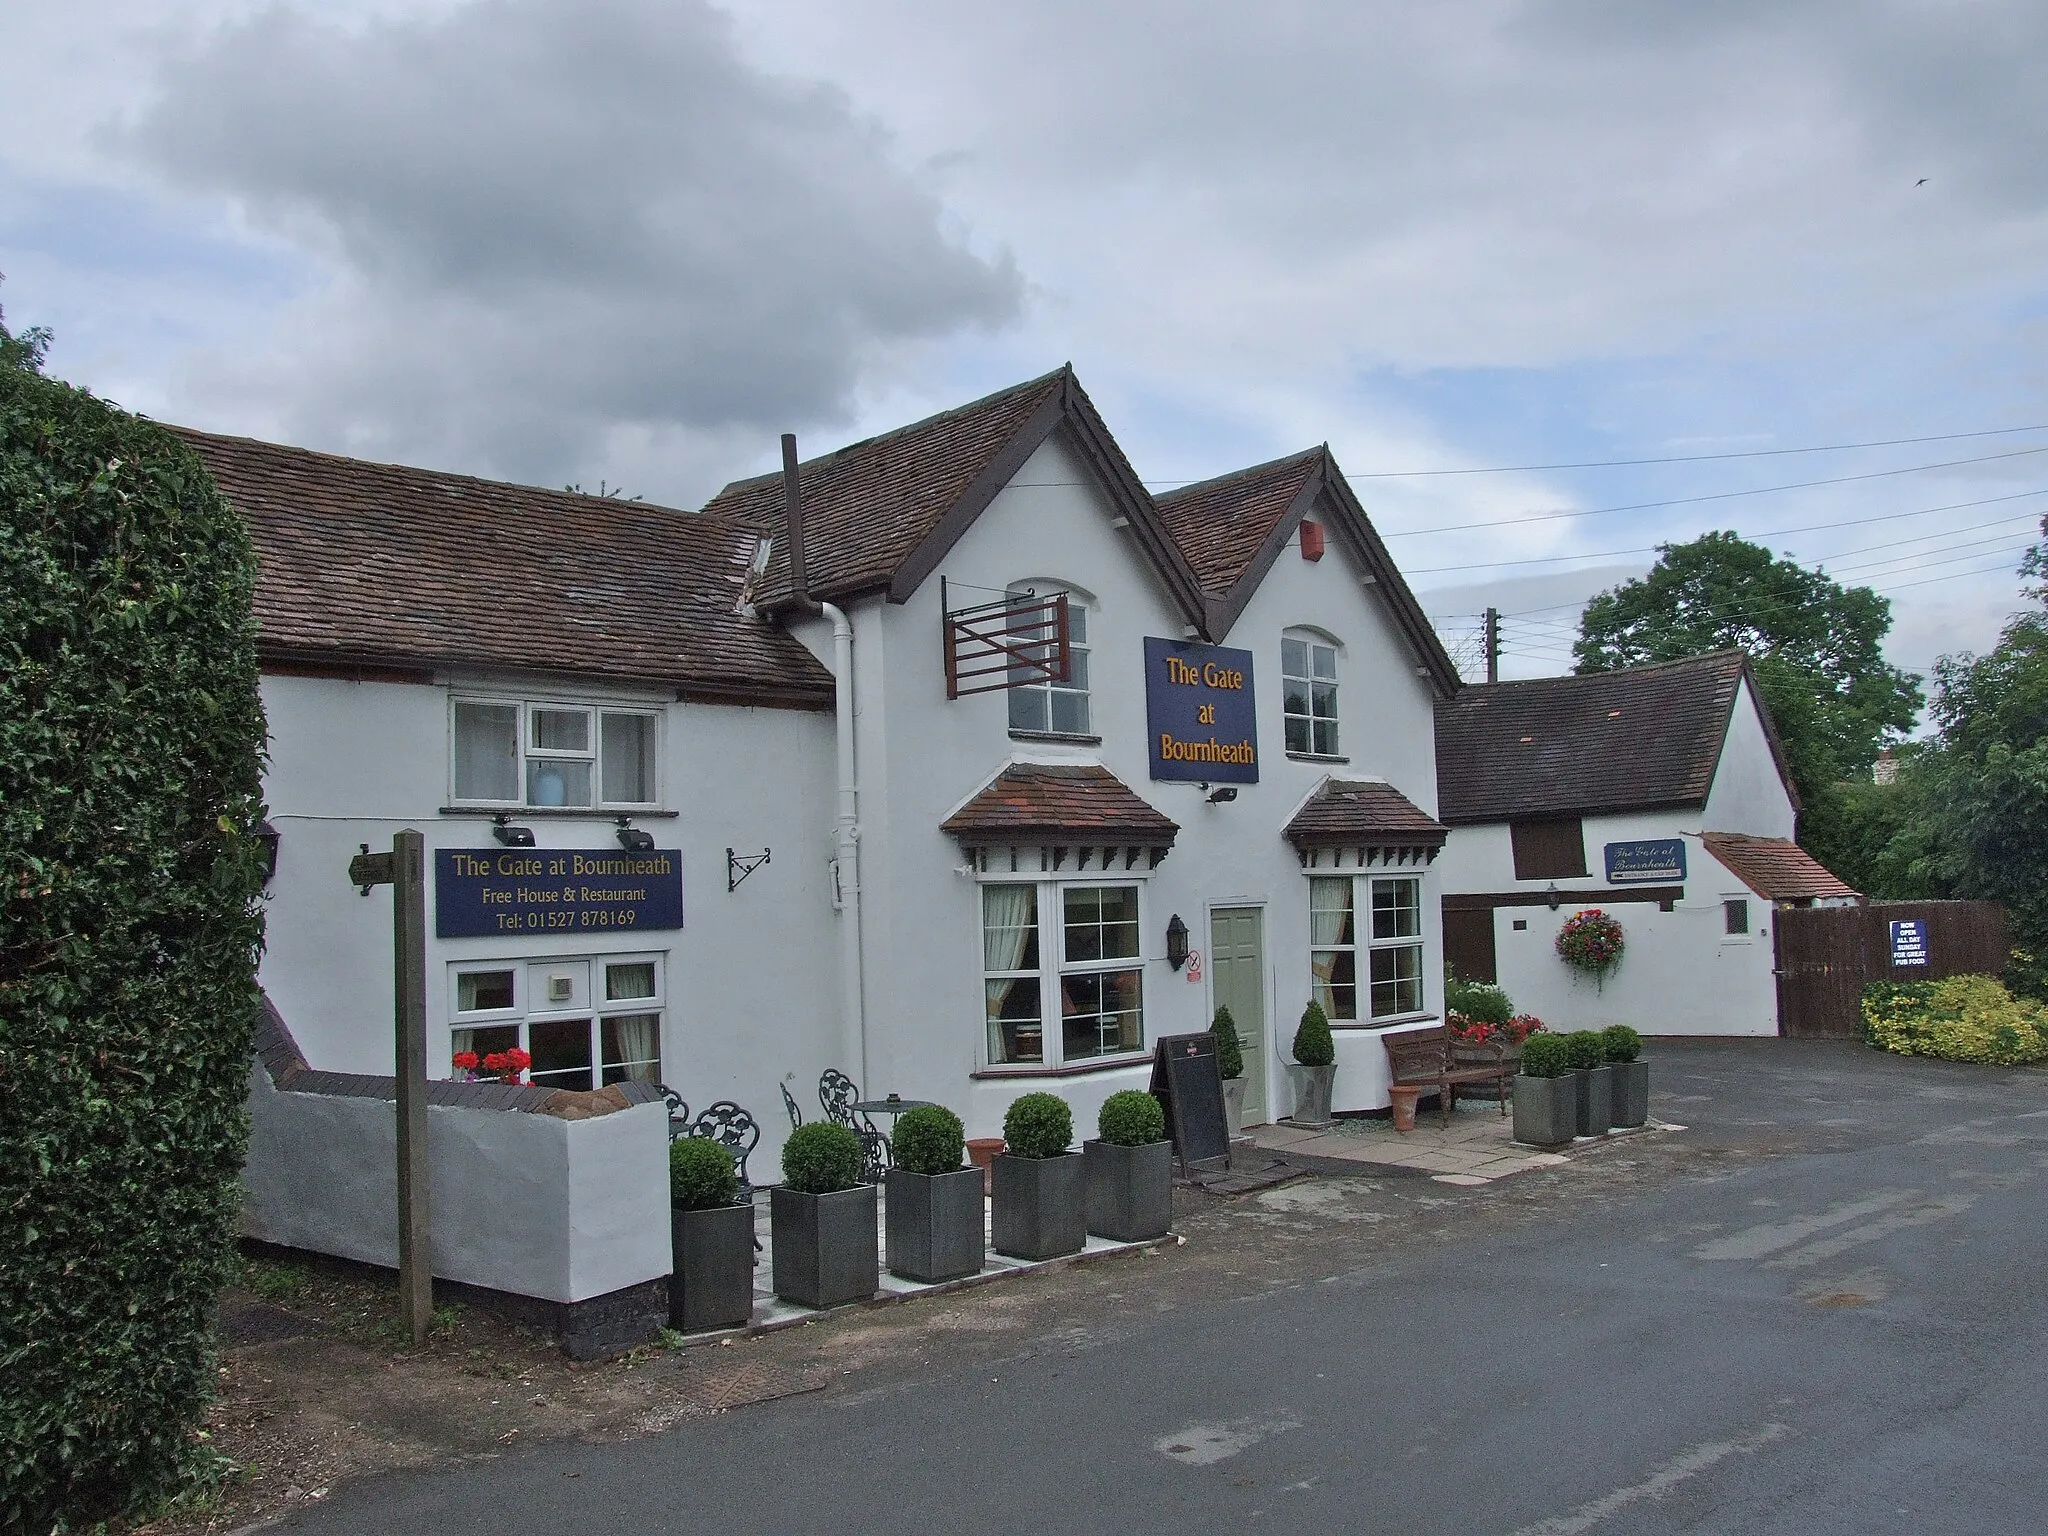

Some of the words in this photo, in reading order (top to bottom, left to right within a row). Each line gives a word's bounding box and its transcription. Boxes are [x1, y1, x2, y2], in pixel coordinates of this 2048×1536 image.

[1166, 657, 1199, 685] The
[1204, 662, 1243, 689] Gate
[1199, 703, 1215, 724] at
[1161, 733, 1254, 764] Bournheath
[1614, 847, 1633, 858] The
[1635, 846, 1659, 857] Gate
[1661, 846, 1674, 855] at
[452, 854, 491, 876] The
[498, 854, 542, 875] Gate
[549, 857, 566, 875] at
[573, 854, 671, 875] Bournheath
[482, 888, 512, 904] Free
[517, 887, 558, 903] House
[563, 887, 575, 902] &
[581, 886, 646, 902] Restaurant
[496, 913, 522, 929] Tel:
[528, 912, 575, 928] 01527
[581, 910, 635, 926] 878169
